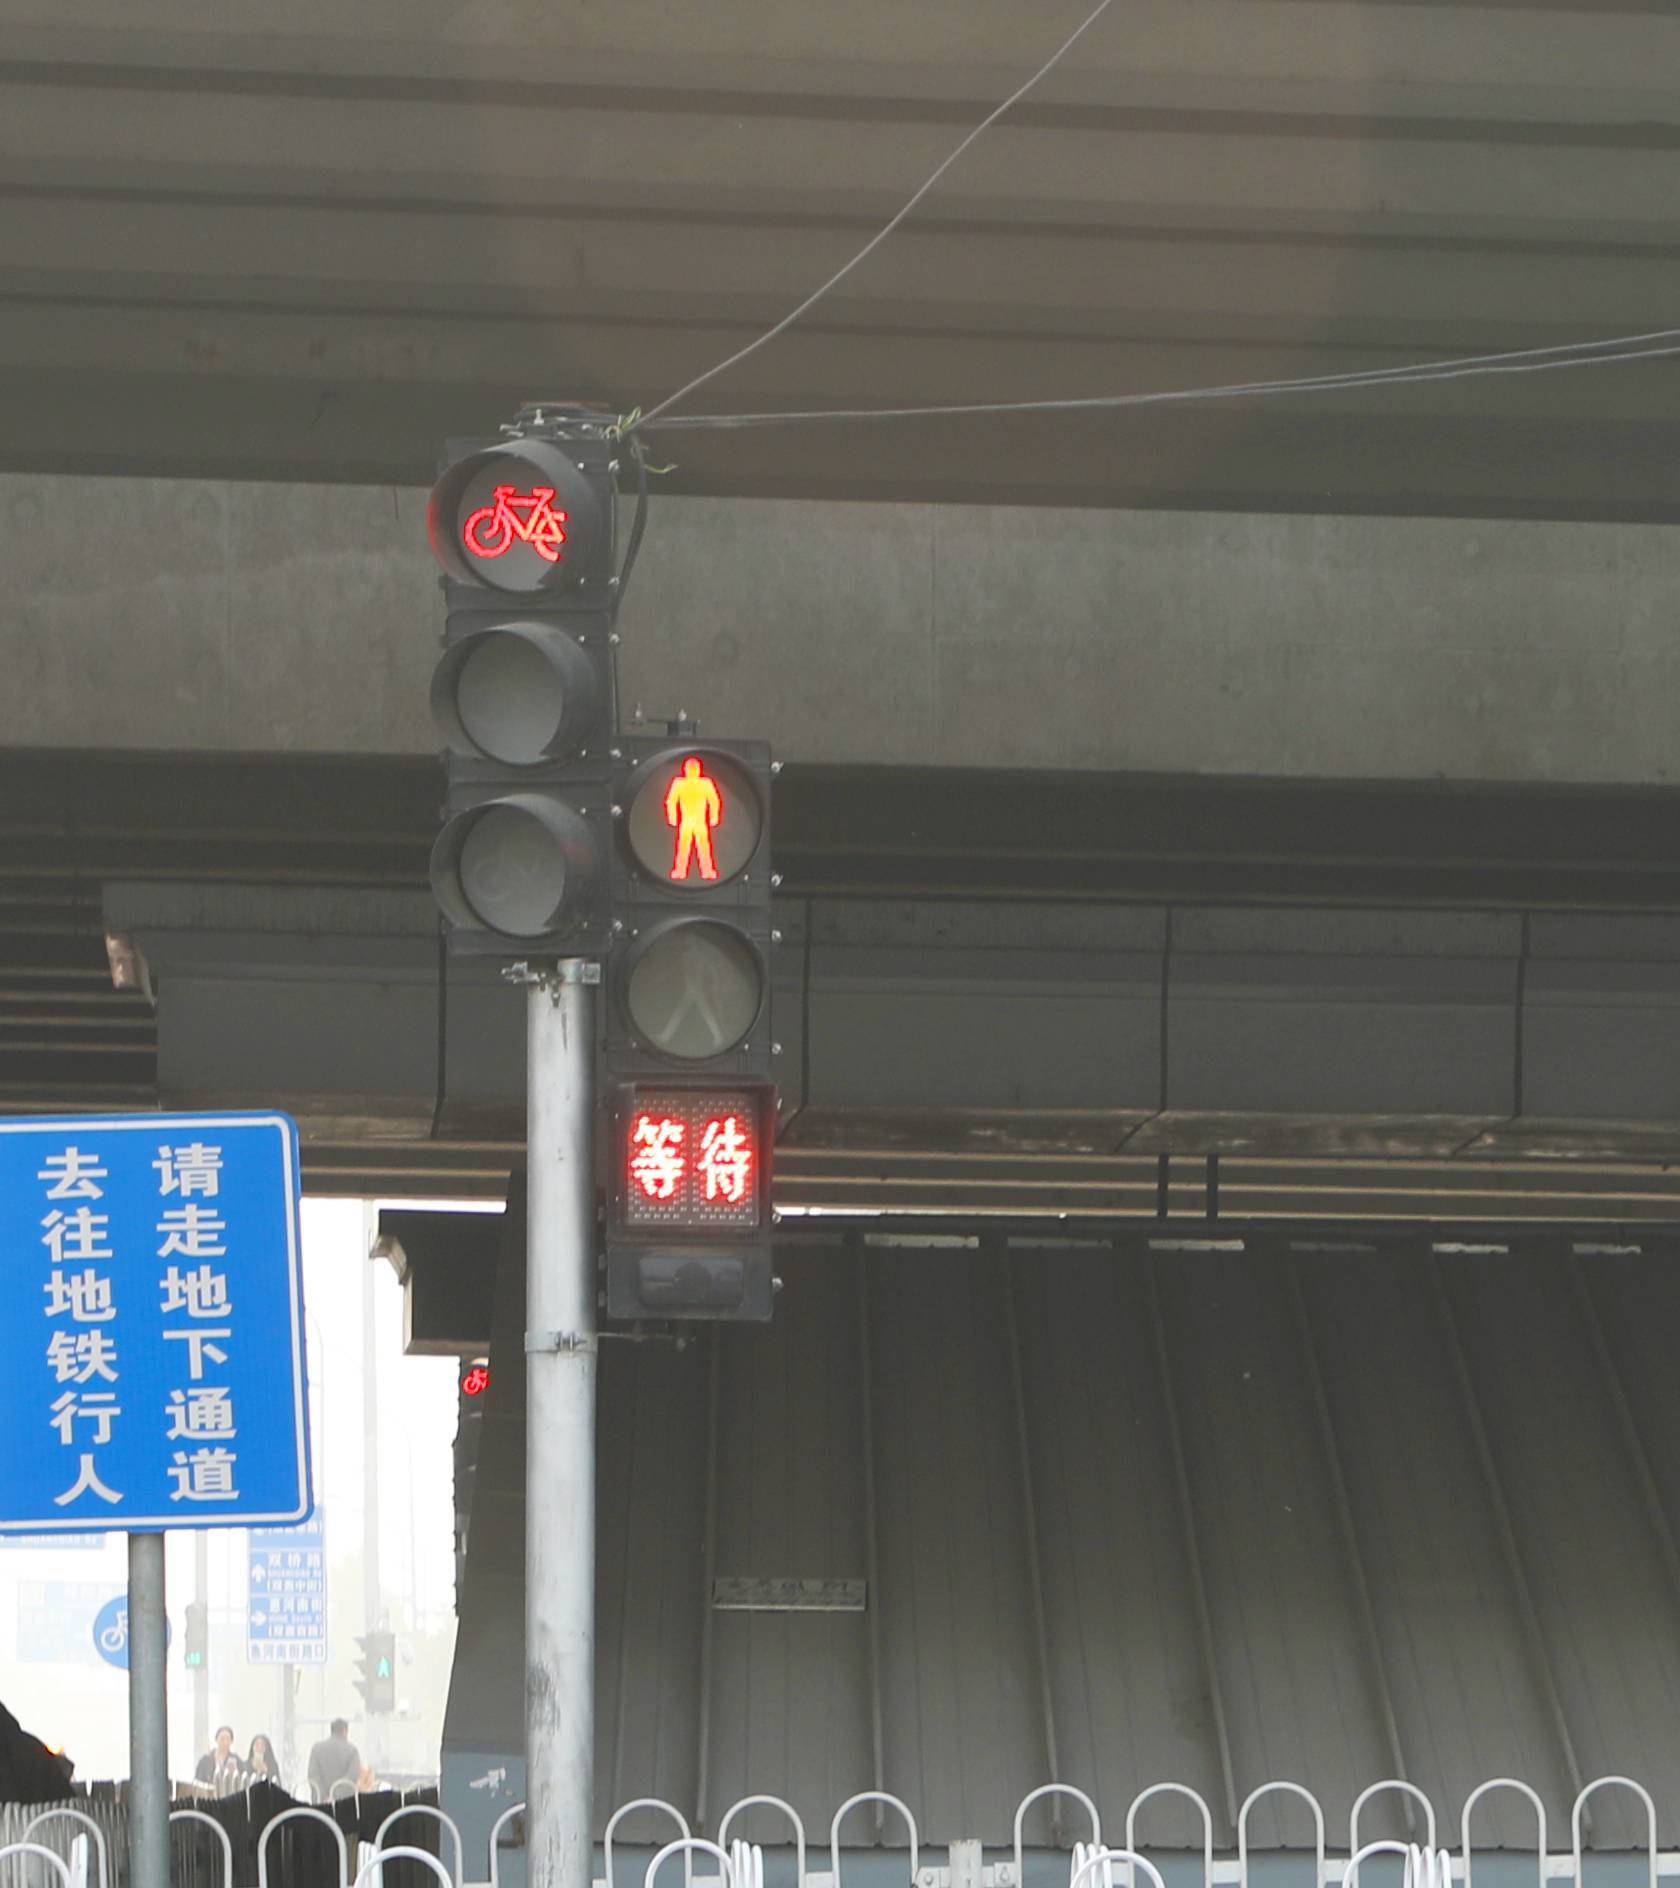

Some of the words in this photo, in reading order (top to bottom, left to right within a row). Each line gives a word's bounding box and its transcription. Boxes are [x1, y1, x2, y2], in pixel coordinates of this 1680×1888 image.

[37, 1146, 124, 1506] 去往地铁行人
[152, 1142, 240, 1502] 请走地下通道
[631, 1116, 752, 1202] 等待
